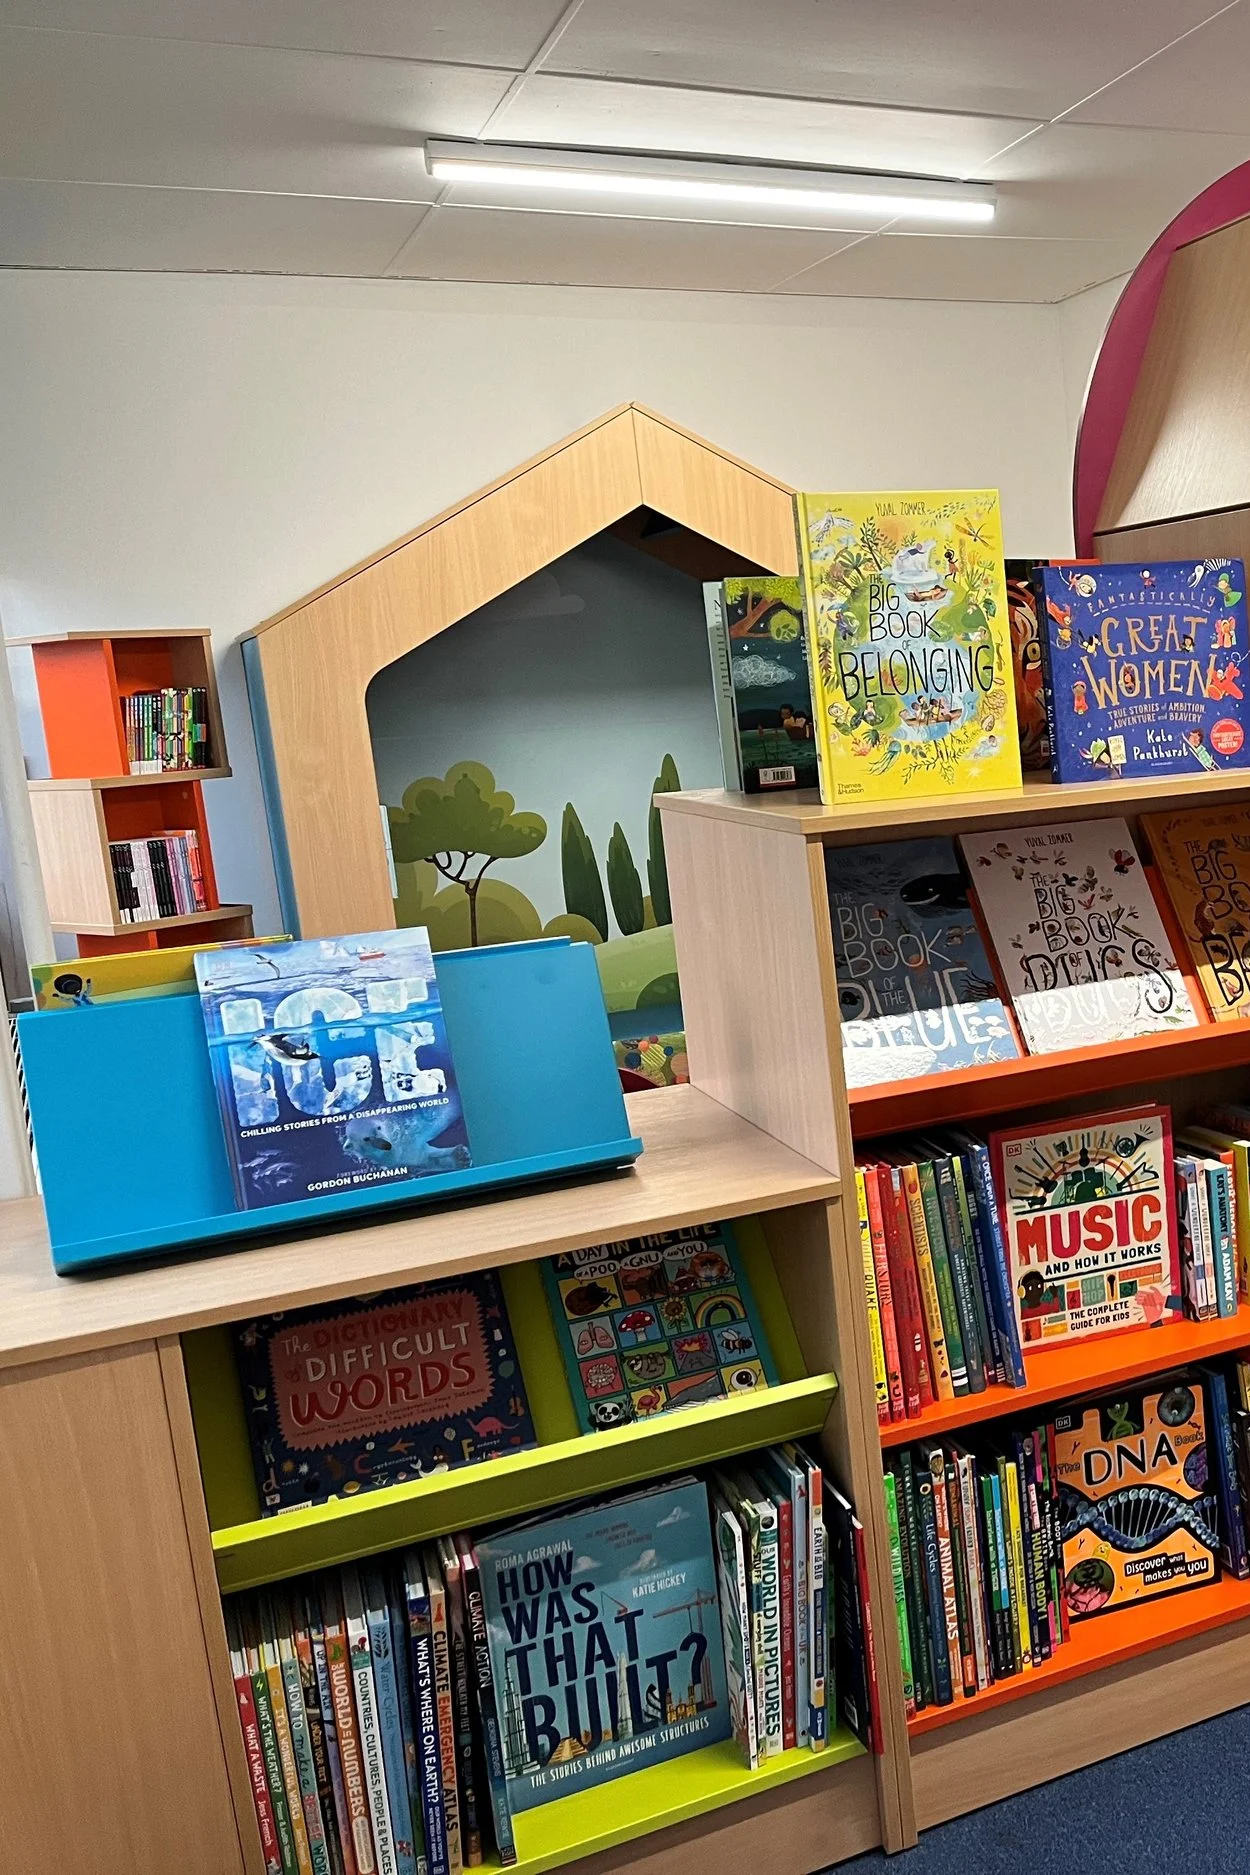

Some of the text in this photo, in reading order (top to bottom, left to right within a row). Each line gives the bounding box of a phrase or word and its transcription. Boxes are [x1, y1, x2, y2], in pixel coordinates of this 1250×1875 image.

[875, 501, 926, 516] YUVAL ZOMMER
[869, 574, 884, 585] THE
[869, 583, 900, 612] BIG
[1087, 591, 1217, 613] FANTASTICALLY
[869, 609, 941, 642] BOOK
[902, 640, 911, 650] OF
[1100, 615, 1207, 659] GREAT
[838, 645, 995, 702] BELONGING
[1080, 653, 1217, 710] WOMEN
[1108, 707, 1126, 720] TRUE
[1129, 703, 1160, 718] STORIES
[1114, 713, 1156, 729] ADVENTURE
[1169, 712, 1202, 723] BRAVERY
[1133, 743, 1188, 760] Pankhurst
[1147, 729, 1172, 743] Kate
[1024, 833, 1074, 848] YUVAL ZOMMER
[1030, 872, 1050, 887] THE
[1191, 851, 1237, 885] BIG
[834, 892, 854, 905] THE
[1034, 884, 1076, 919] BIG
[837, 903, 884, 942] BIG
[1042, 904, 1136, 952] BOOK
[843, 928, 952, 978] BOOK
[1069, 951, 1084, 967] OF
[219, 978, 447, 1127] ICE
[240, 1097, 449, 1138] CHILLING STORIES FROM A DISAPPEARING WORLD
[307, 1166, 408, 1192] GORDON BUCHANAN
[557, 1224, 716, 1268] A DAY IN THE LIFE
[907, 1198, 930, 1257] SCIENTISTS
[1016, 1194, 1162, 1266] MUSIC
[589, 1242, 704, 1277] POO GNU YOU
[1045, 1243, 1161, 1276] AND HOW IT WORKS
[281, 1298, 465, 1356] The DICTIONARY
[1070, 1301, 1130, 1321] THE COMPLETE
[1070, 1311, 1130, 1331] GUIDE FOR KIDS
[306, 1322, 471, 1382] DIFFICULT
[290, 1351, 476, 1428] WORDS
[1058, 1432, 1204, 1487] The DNA Book
[495, 1539, 573, 1571] ROMA AGRAWAL
[1030, 1532, 1049, 1621] HUMAN BODY!
[1126, 1556, 1166, 1575] Discover
[1145, 1560, 1207, 1582] makes you
[497, 1551, 574, 1605] HOW
[632, 1572, 686, 1599] KATIE HICKEY
[937, 1536, 960, 1641] ANIMAL ATLAS
[500, 1582, 599, 1645] WAS
[467, 1591, 492, 1689] CLIMATE ACTION
[505, 1608, 644, 1696] THAT
[763, 1554, 779, 1737] WORLD IN PICTURES
[522, 1632, 708, 1765] BUILT?
[331, 1669, 365, 1817] WORLD NUMBERS
[416, 1638, 438, 1804] WHAT'S WHERE ON EARTH?
[435, 1630, 456, 1832] CLIMATE EMERGENCY ATLAS
[246, 1723, 267, 1793] WHAT A WASTE
[257, 1695, 282, 1793] WHAT'S THE WEATHER?
[530, 1716, 709, 1788] THE STORIES BEHIND AWESOME STRUCTURES
[355, 1671, 393, 1875] COUNTRIES, CULTURES, PEOPLE & PLACES
